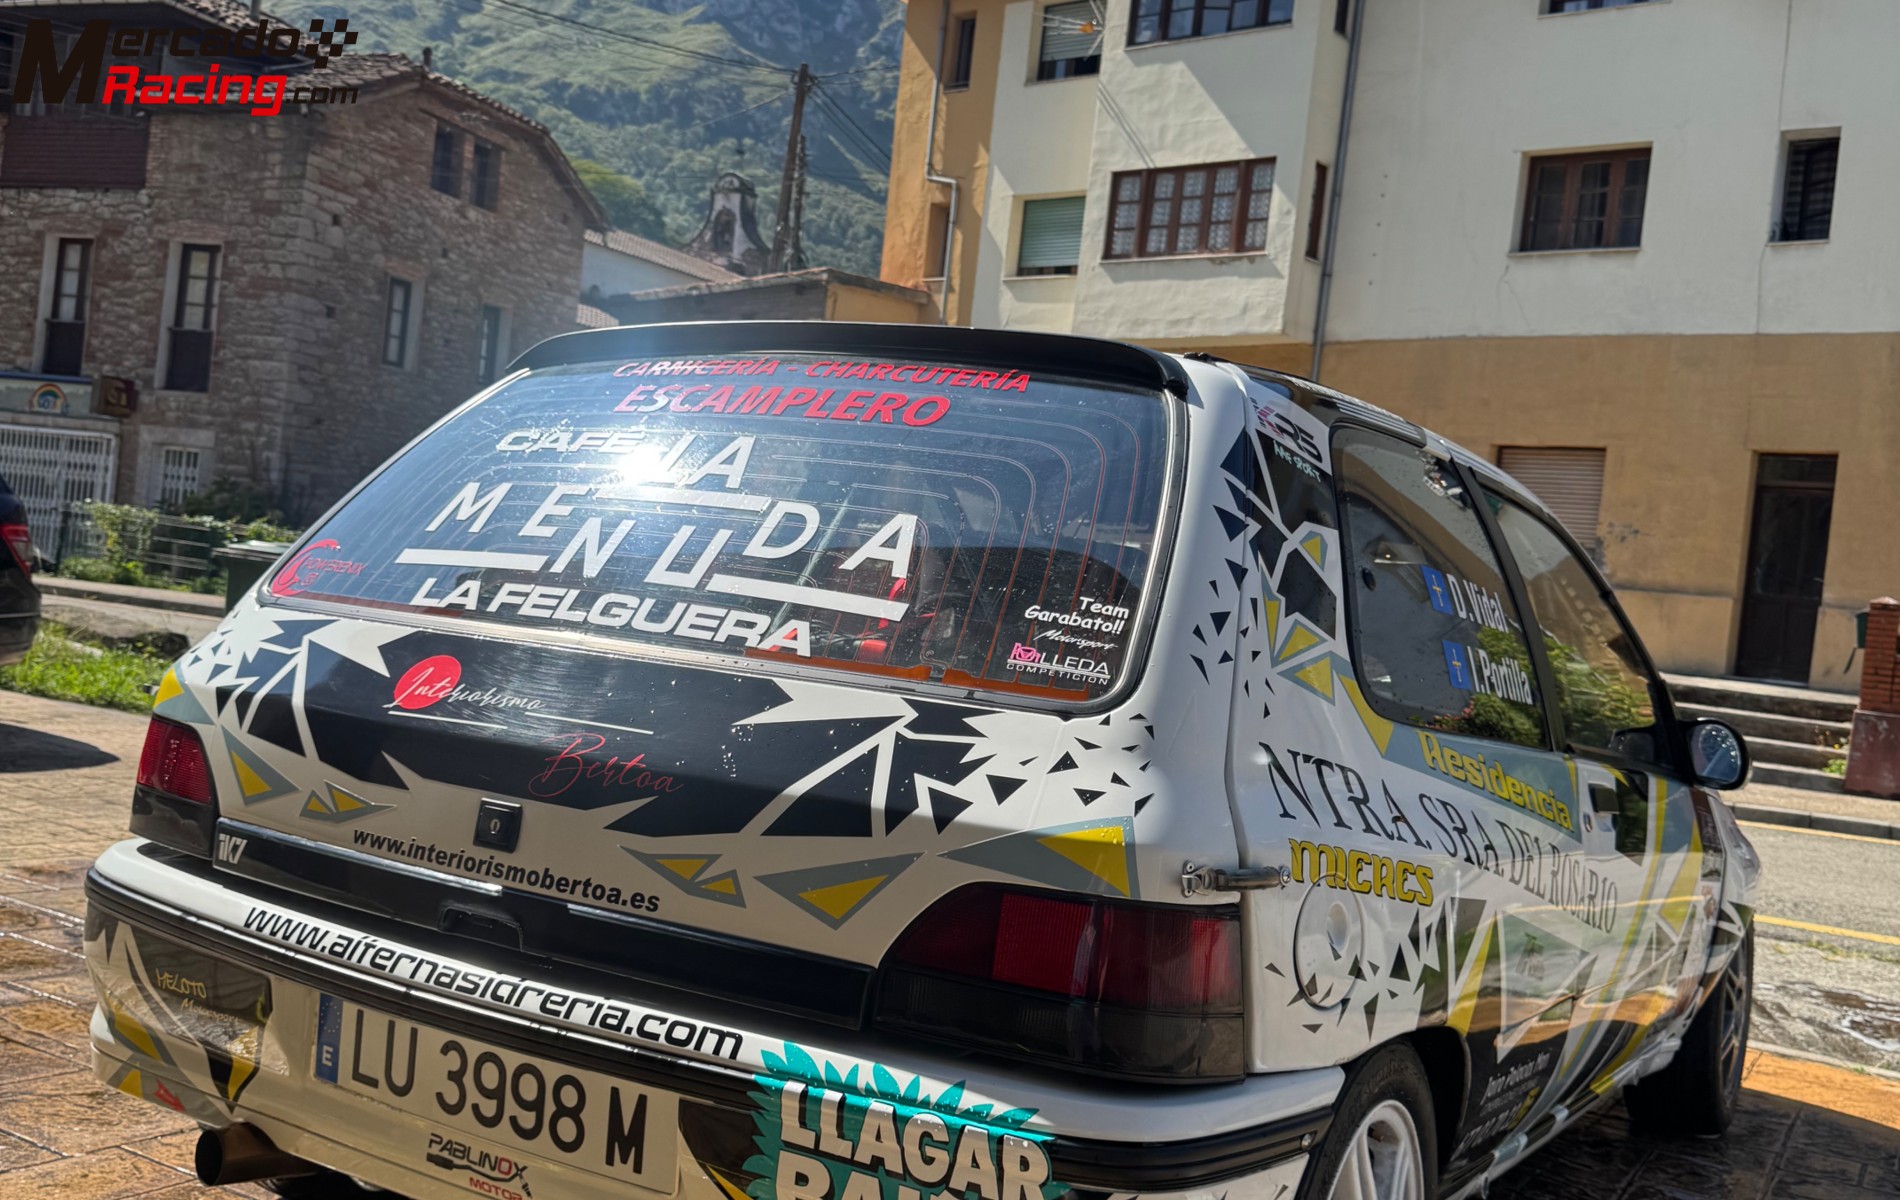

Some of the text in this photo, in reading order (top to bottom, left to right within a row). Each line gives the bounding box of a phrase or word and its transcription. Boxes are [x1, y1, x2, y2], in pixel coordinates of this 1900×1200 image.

[613, 384, 951, 426] ESCAMPLERO
[805, 360, 1031, 393] CHARCUTERÍA
[645, 432, 756, 489] LA
[408, 577, 812, 658] LA FELGUERA
[1024, 605, 1126, 635] Garabato!!
[1079, 596, 1130, 619] Team
[1006, 664, 1109, 686] COMPETICION
[528, 733, 684, 798] Bertoa
[1417, 730, 1575, 832] Residencia
[353, 827, 661, 913] www.interiorismobertoa.es
[1495, 819, 1547, 900] DEL
[1549, 842, 1619, 934] ROSARIO
[321, 1044, 333, 1067] E
[352, 1008, 648, 1175] LU 3998 M
[428, 1132, 529, 1177] PABLINOX
[780, 1079, 1050, 1200] LLAGAR
